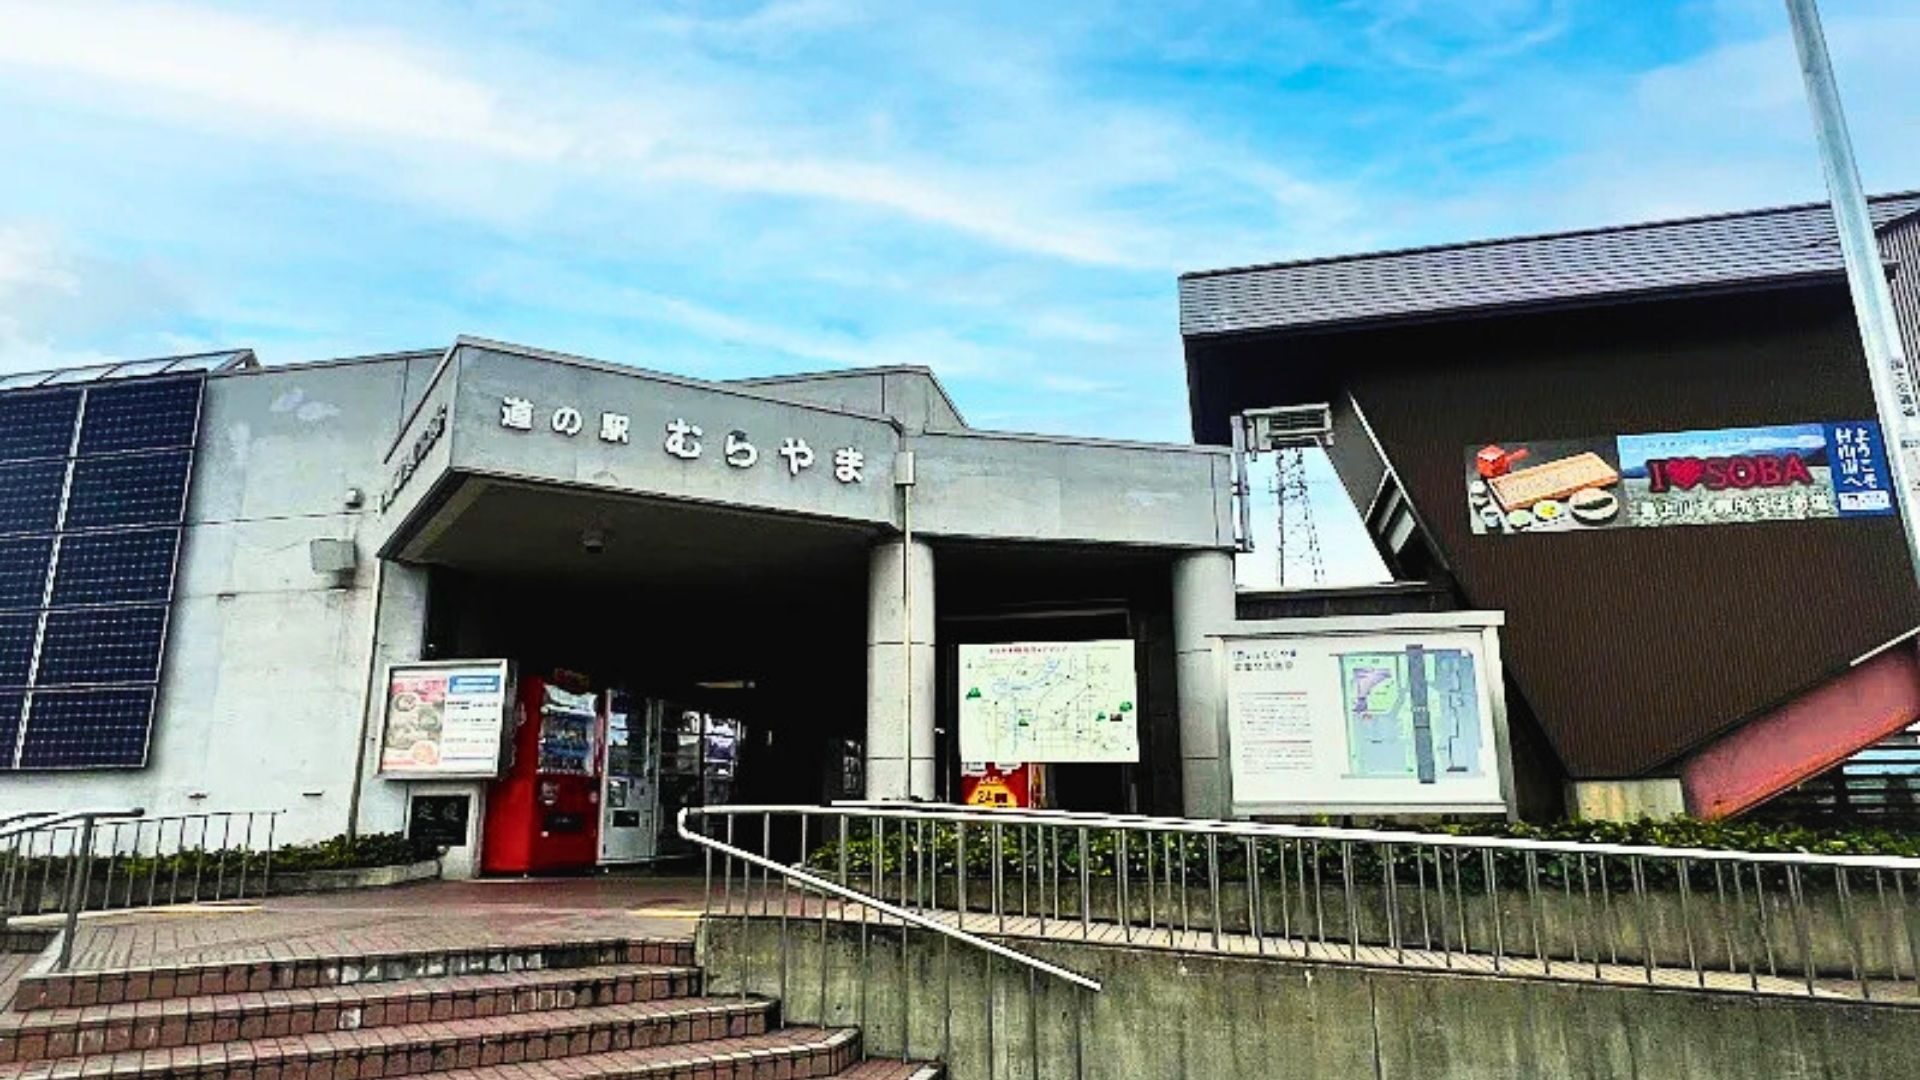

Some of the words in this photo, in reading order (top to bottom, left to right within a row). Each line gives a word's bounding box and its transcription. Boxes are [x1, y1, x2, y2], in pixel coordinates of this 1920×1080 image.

[500, 396, 630, 445] 道の駅
[664, 417, 866, 484] むらやま
[1855, 427, 1878, 489] ようこそ
[1648, 461, 1668, 491] I
[1706, 455, 1812, 489] SOBA
